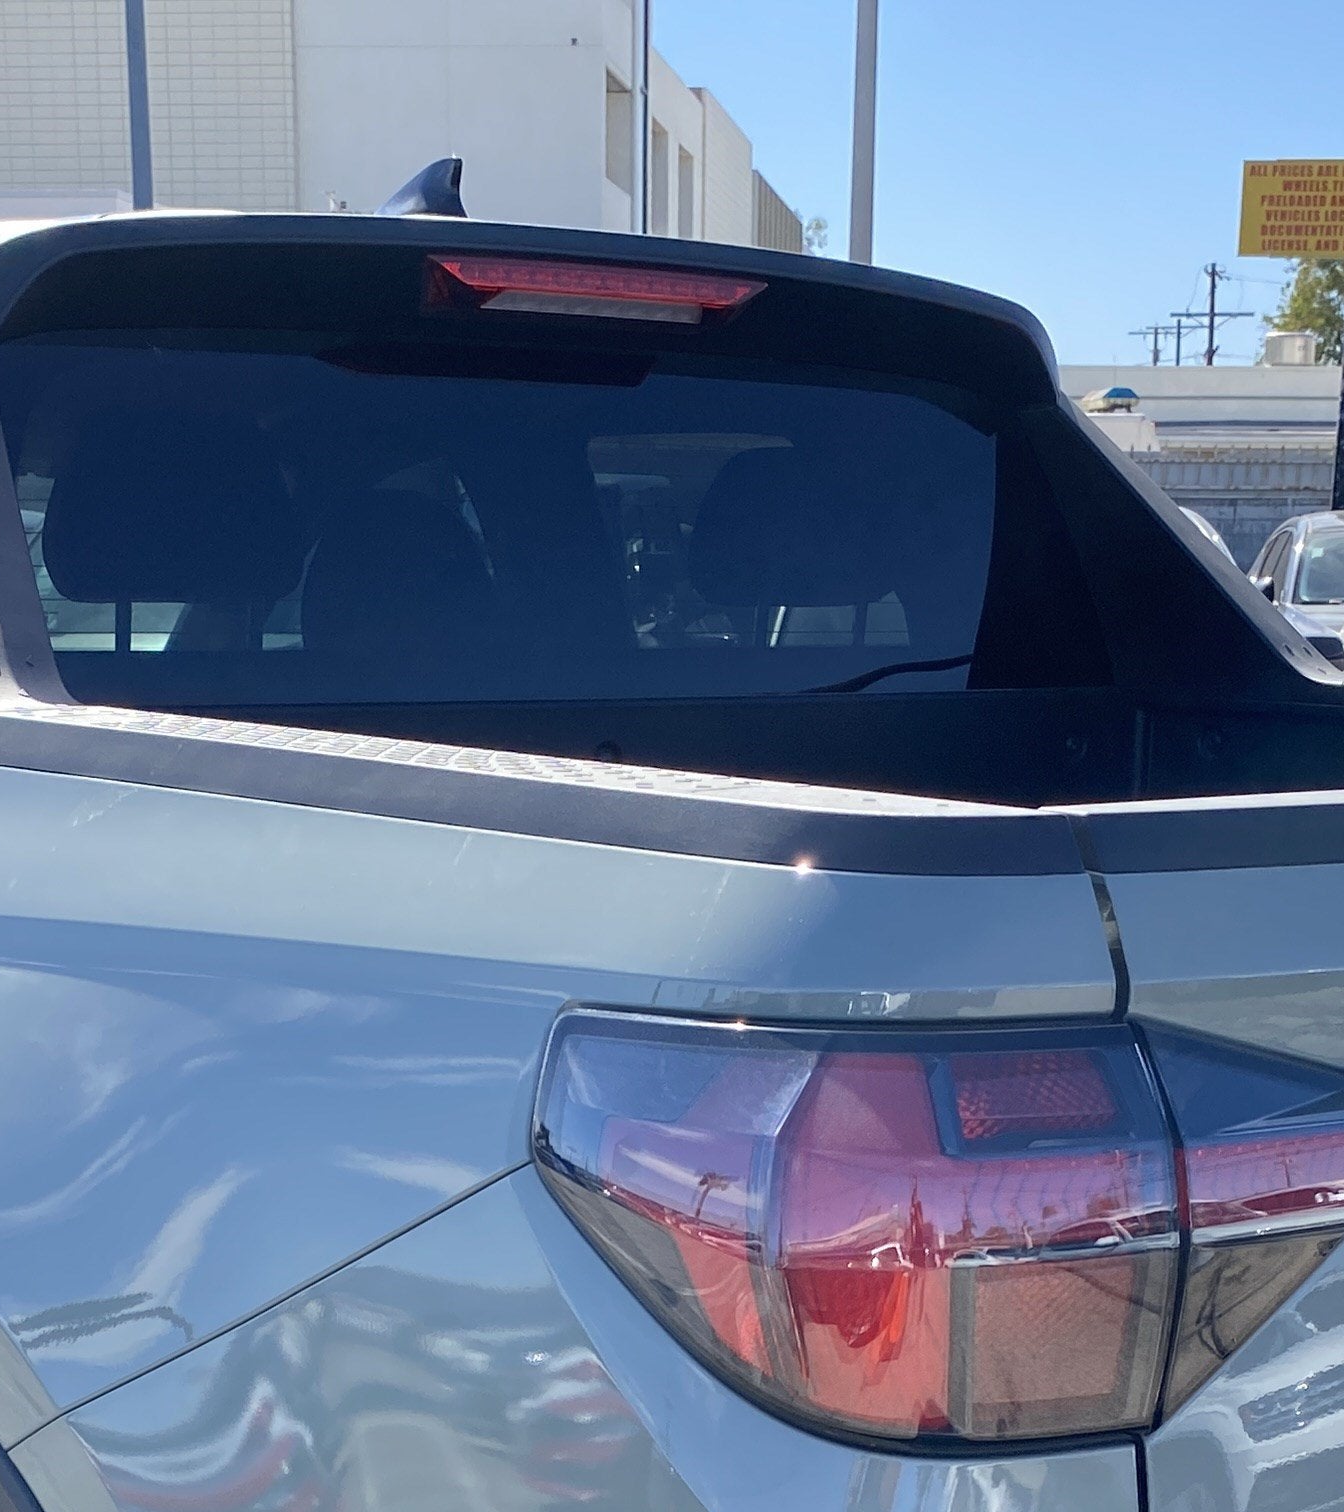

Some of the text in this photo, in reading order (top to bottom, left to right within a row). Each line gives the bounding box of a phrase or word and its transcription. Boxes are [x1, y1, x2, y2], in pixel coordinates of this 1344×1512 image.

[1249, 165, 1268, 177] ALL
[1272, 165, 1314, 177] PRICES
[1317, 165, 1338, 177] ARE
[1261, 194, 1326, 207] PRELOADED
[1264, 209, 1321, 222] VEHICLES
[1315, 239, 1338, 251] AND
